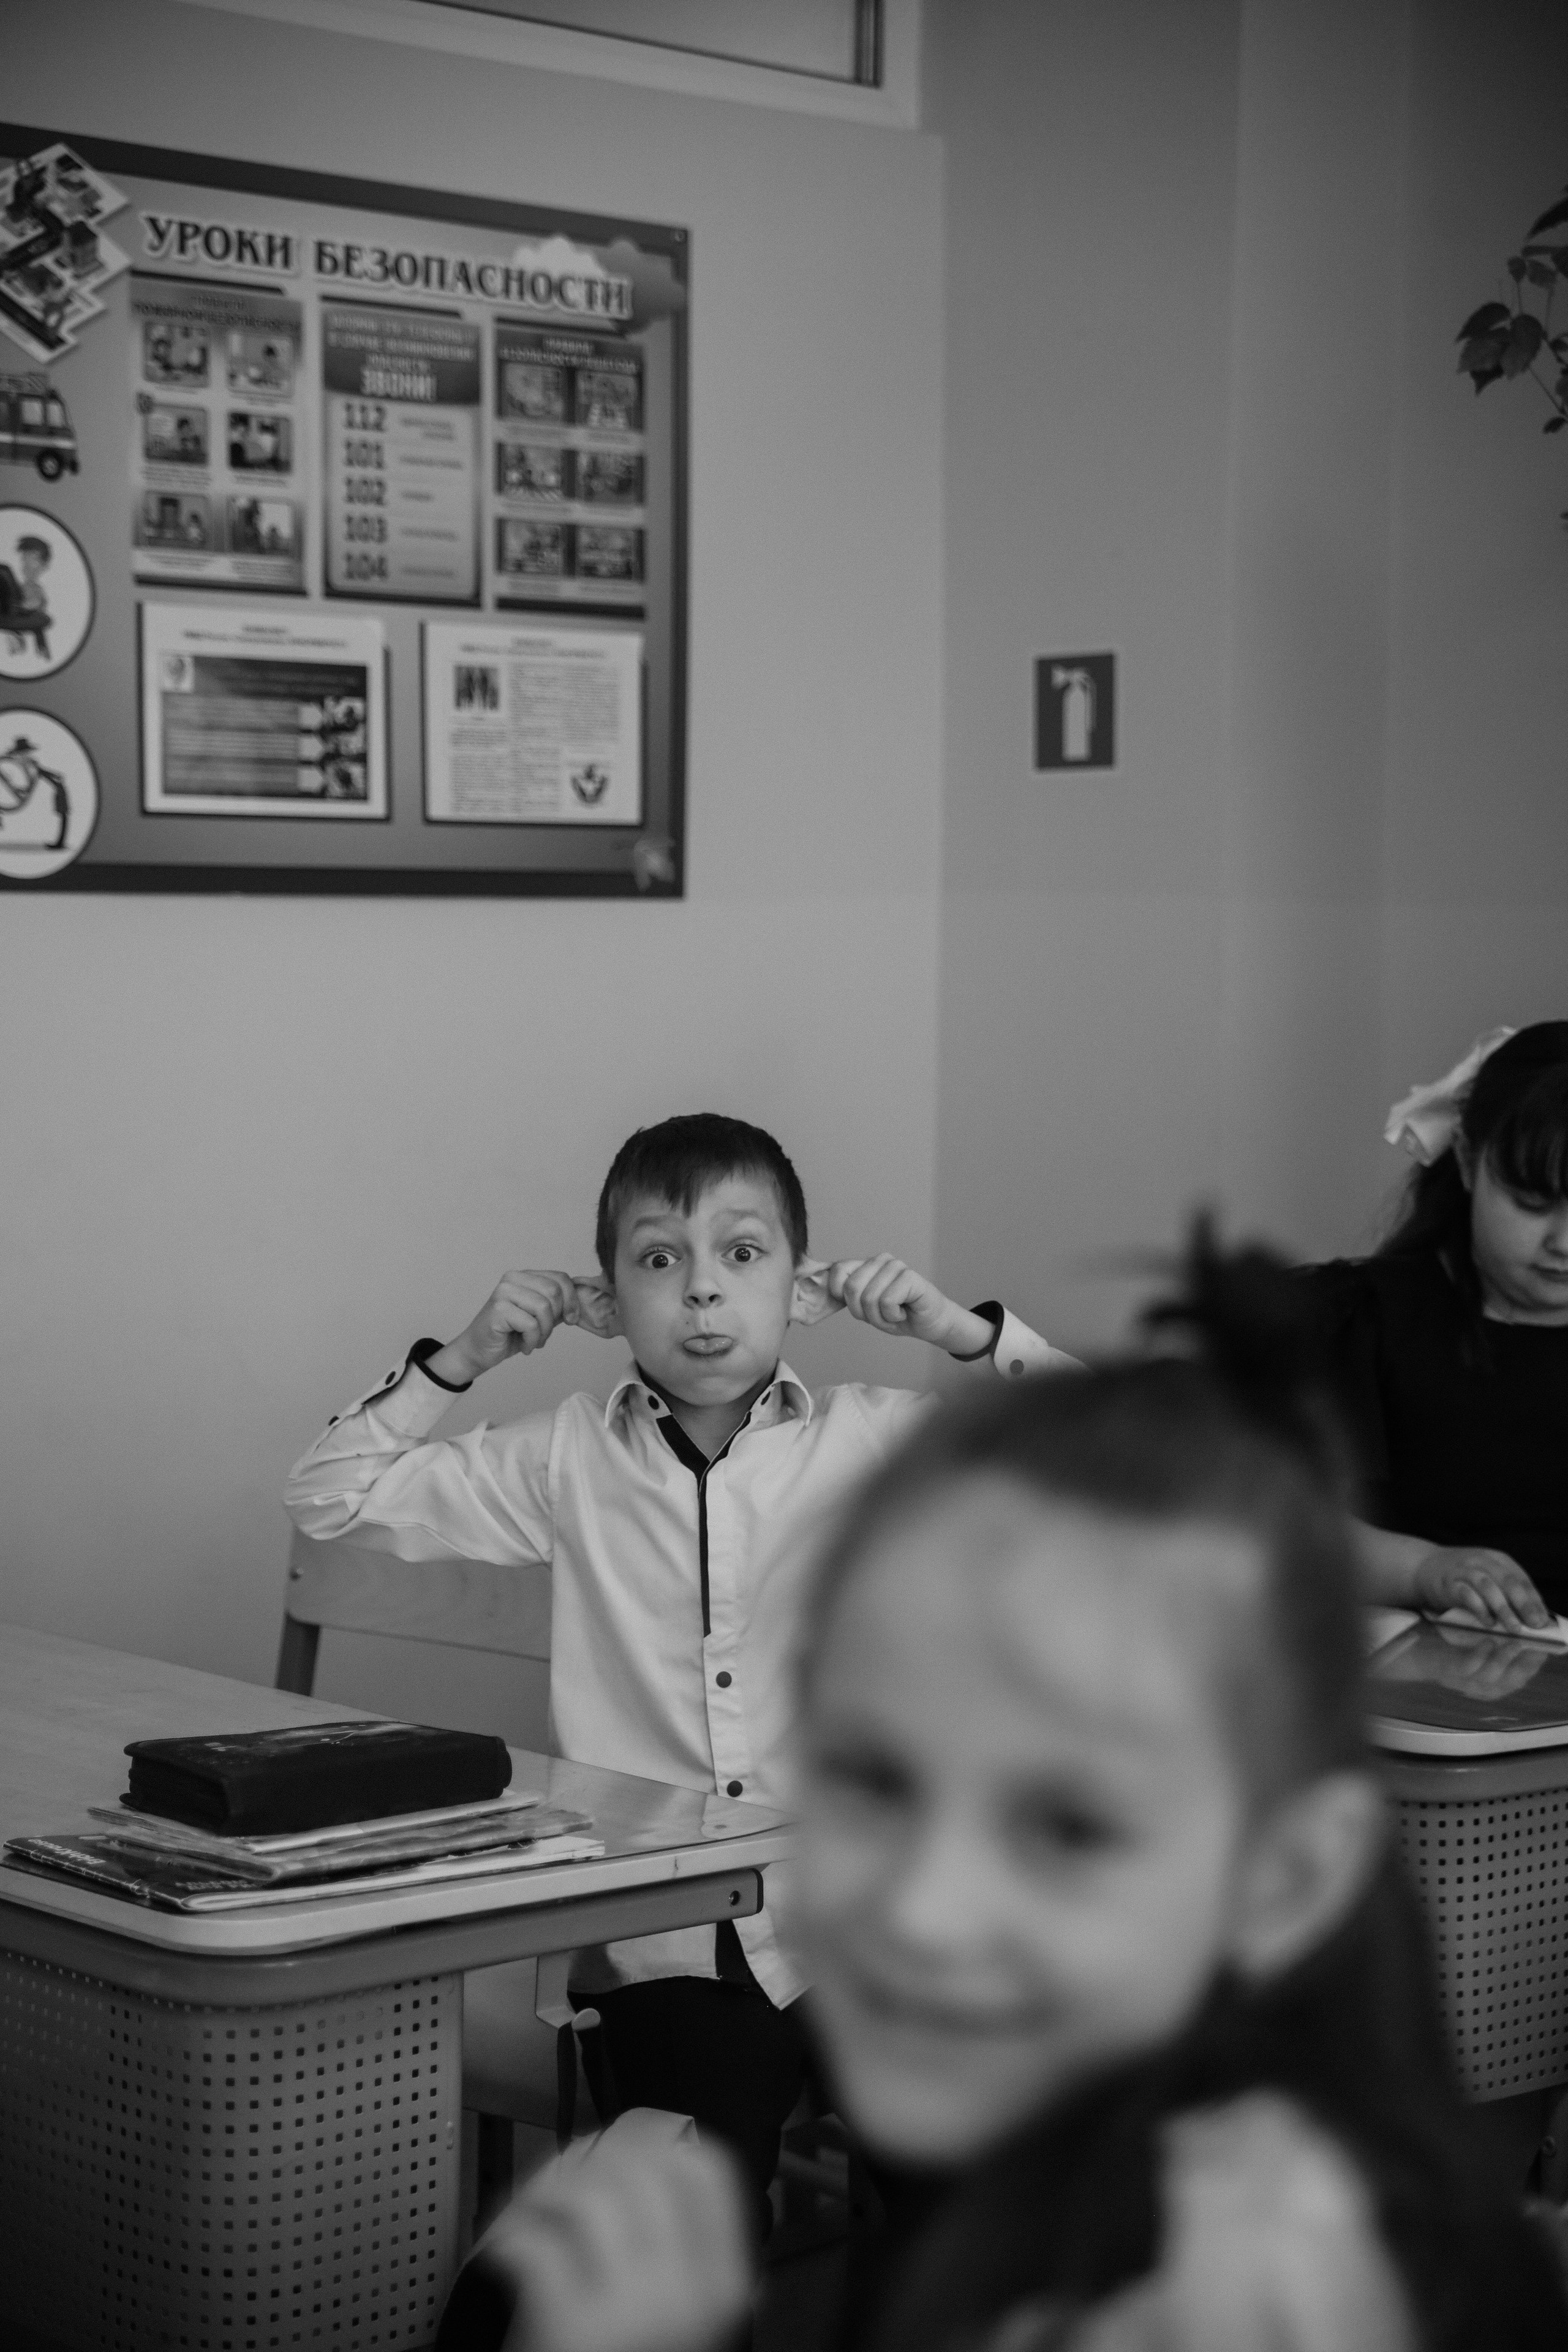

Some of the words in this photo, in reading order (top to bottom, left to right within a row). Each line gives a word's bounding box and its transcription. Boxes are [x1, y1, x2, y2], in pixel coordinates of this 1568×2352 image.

[145, 216, 291, 270] УРОКИ
[314, 241, 627, 315] БЕЗОПАСНОСТИ
[344, 402, 387, 433] 112
[344, 439, 386, 470] 101
[344, 476, 387, 507] 102
[344, 513, 388, 544] 103
[344, 552, 389, 581] 104
